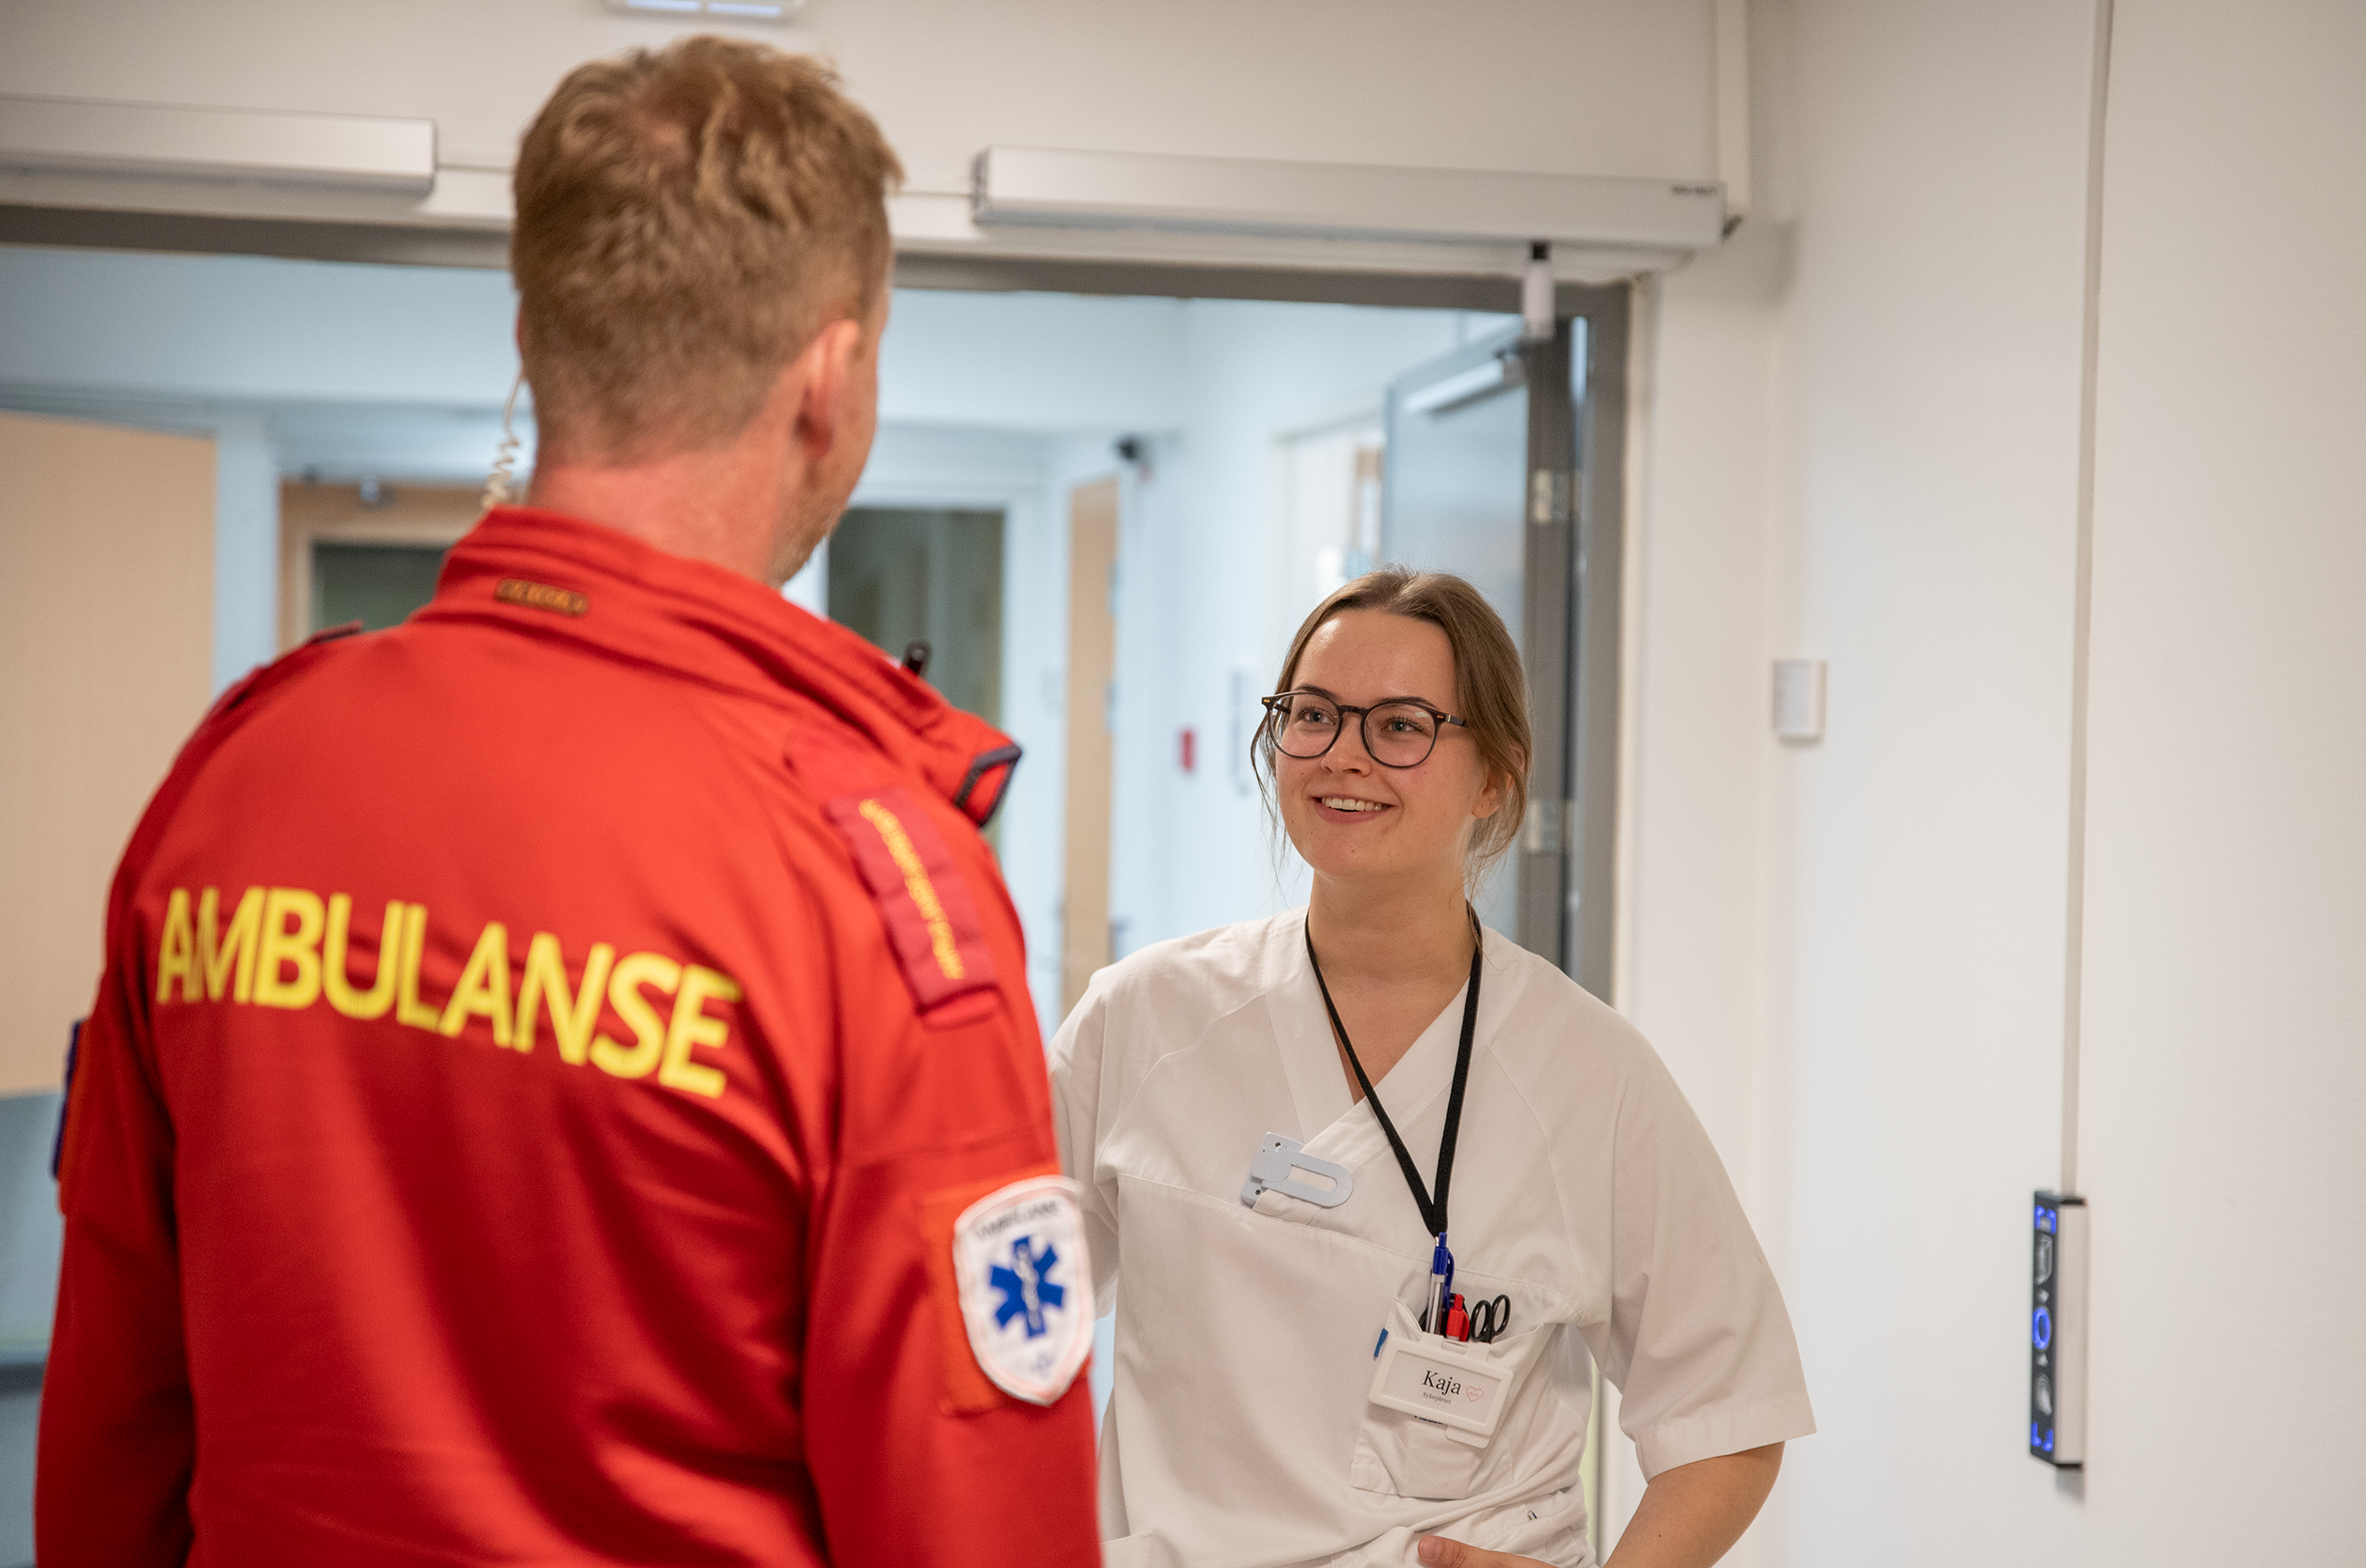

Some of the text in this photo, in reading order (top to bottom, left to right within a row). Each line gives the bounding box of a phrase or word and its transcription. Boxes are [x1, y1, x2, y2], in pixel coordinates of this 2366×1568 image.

[156, 885, 743, 1099] AMBULANSE
[1422, 1370, 1462, 1396] Kaja
[1422, 1391, 1453, 1405] Sykepleier
